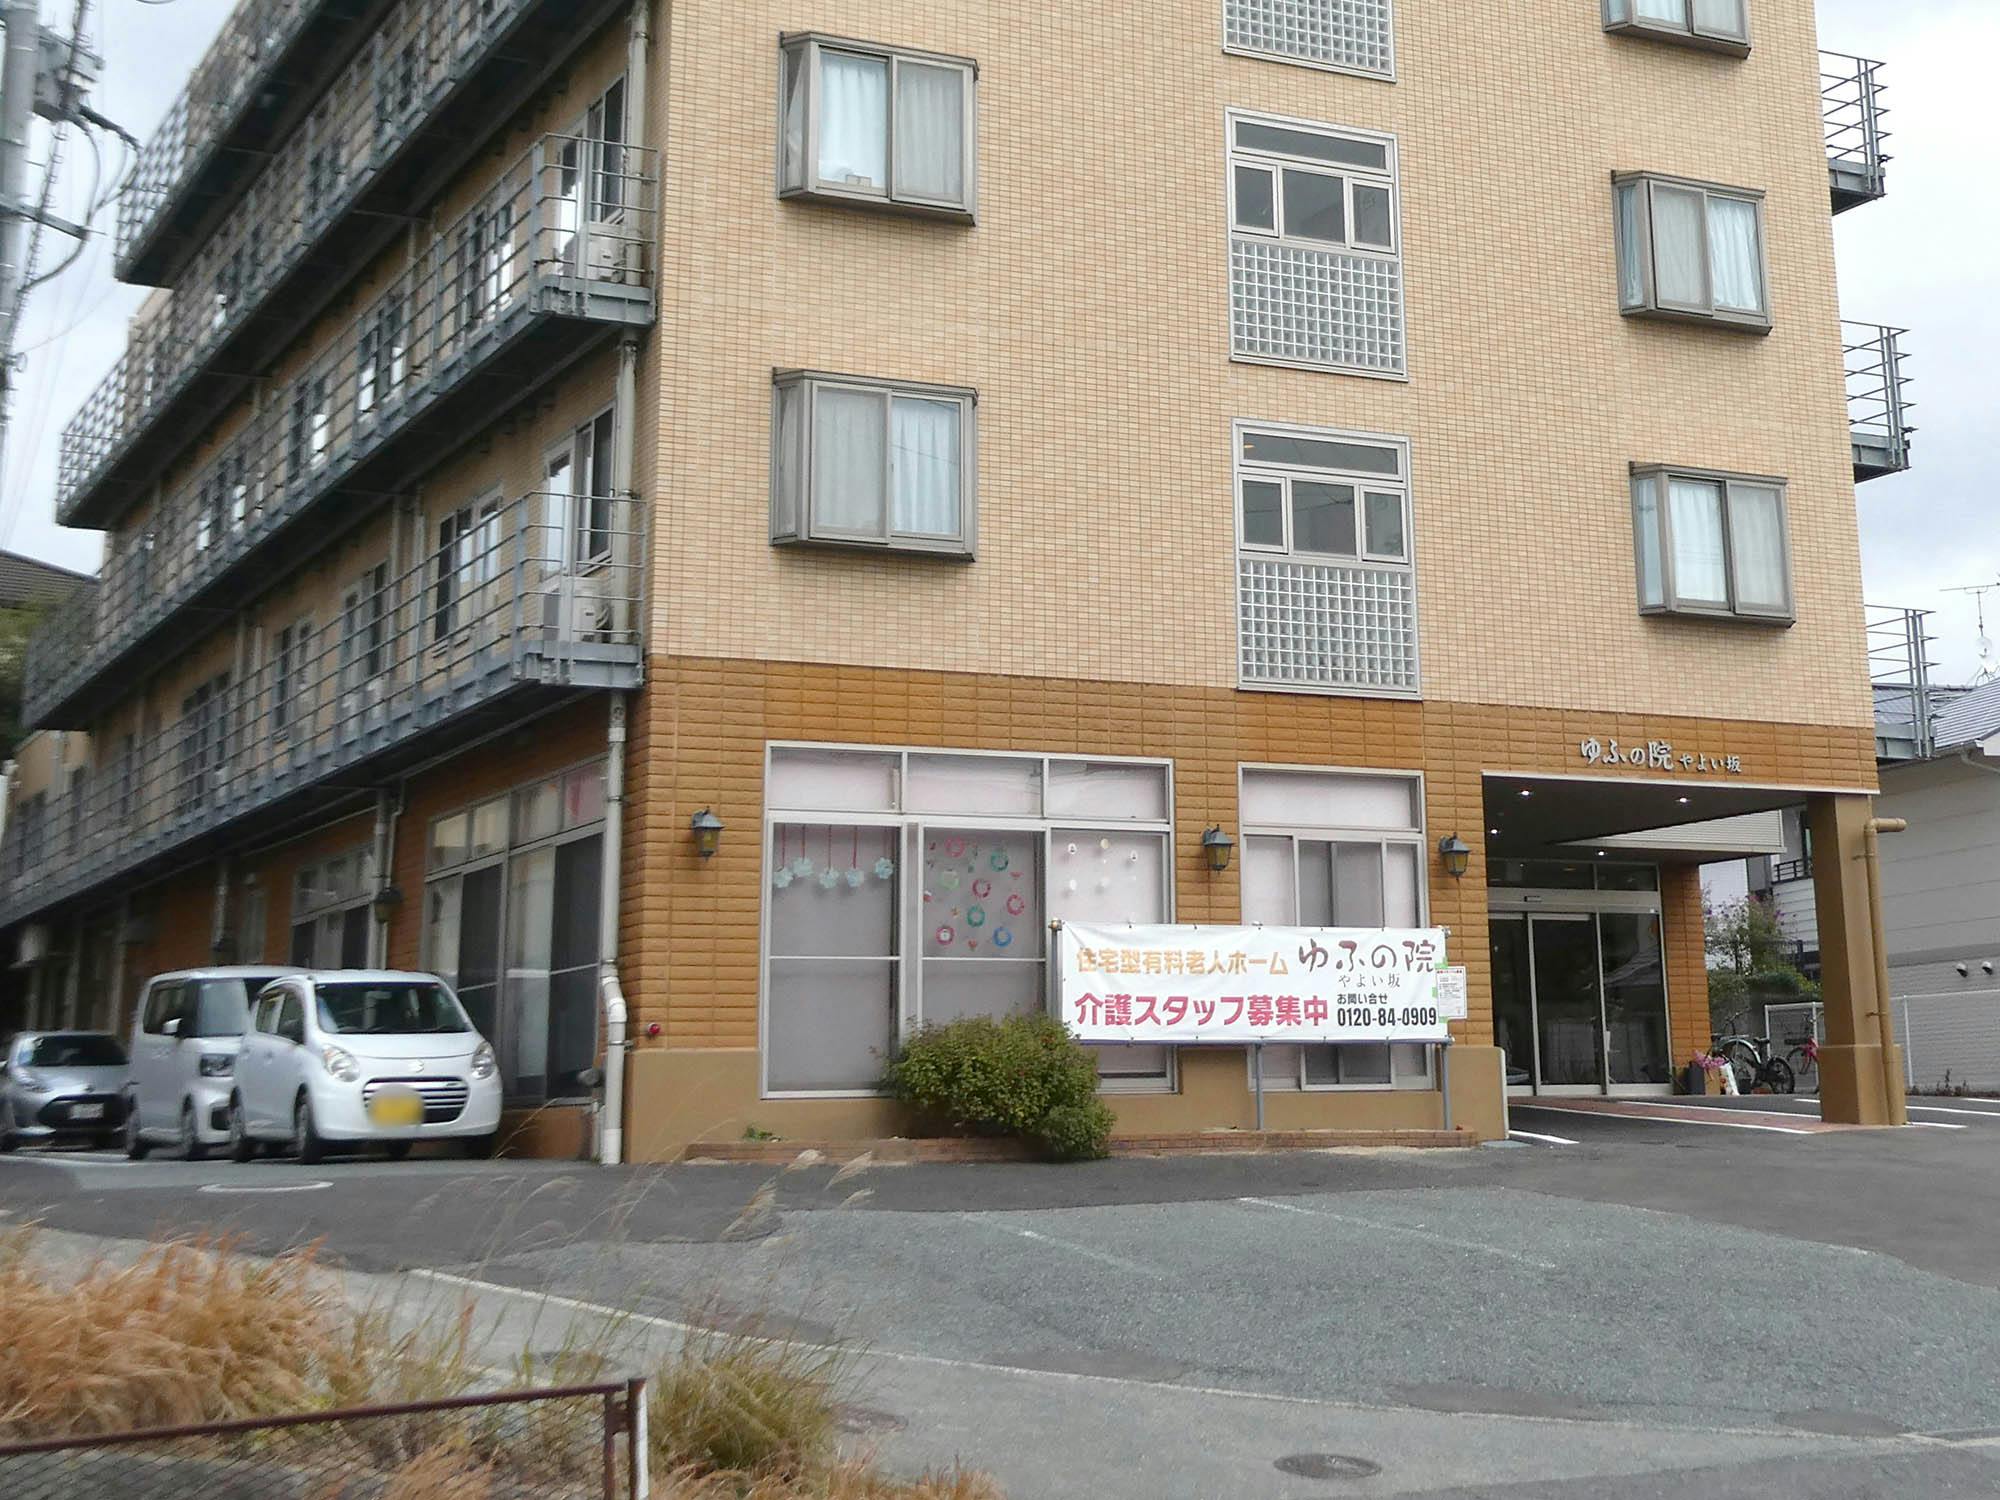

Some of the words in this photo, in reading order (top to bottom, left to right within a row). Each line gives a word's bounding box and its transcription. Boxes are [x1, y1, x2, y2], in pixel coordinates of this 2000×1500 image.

[1580, 738, 1674, 771] ゆふの院
[1681, 753, 1742, 773] やよい坂
[1077, 947, 1288, 975] 住宅型有料老人ホーム
[1299, 938, 1436, 973] ゆふの院
[1338, 973, 1401, 988] やよい坂
[1074, 992, 1328, 1026] 介護スタッフ募集中
[1336, 993, 1388, 1005] お問い合せ
[1337, 1007, 1437, 1027] 0120-84-0909
